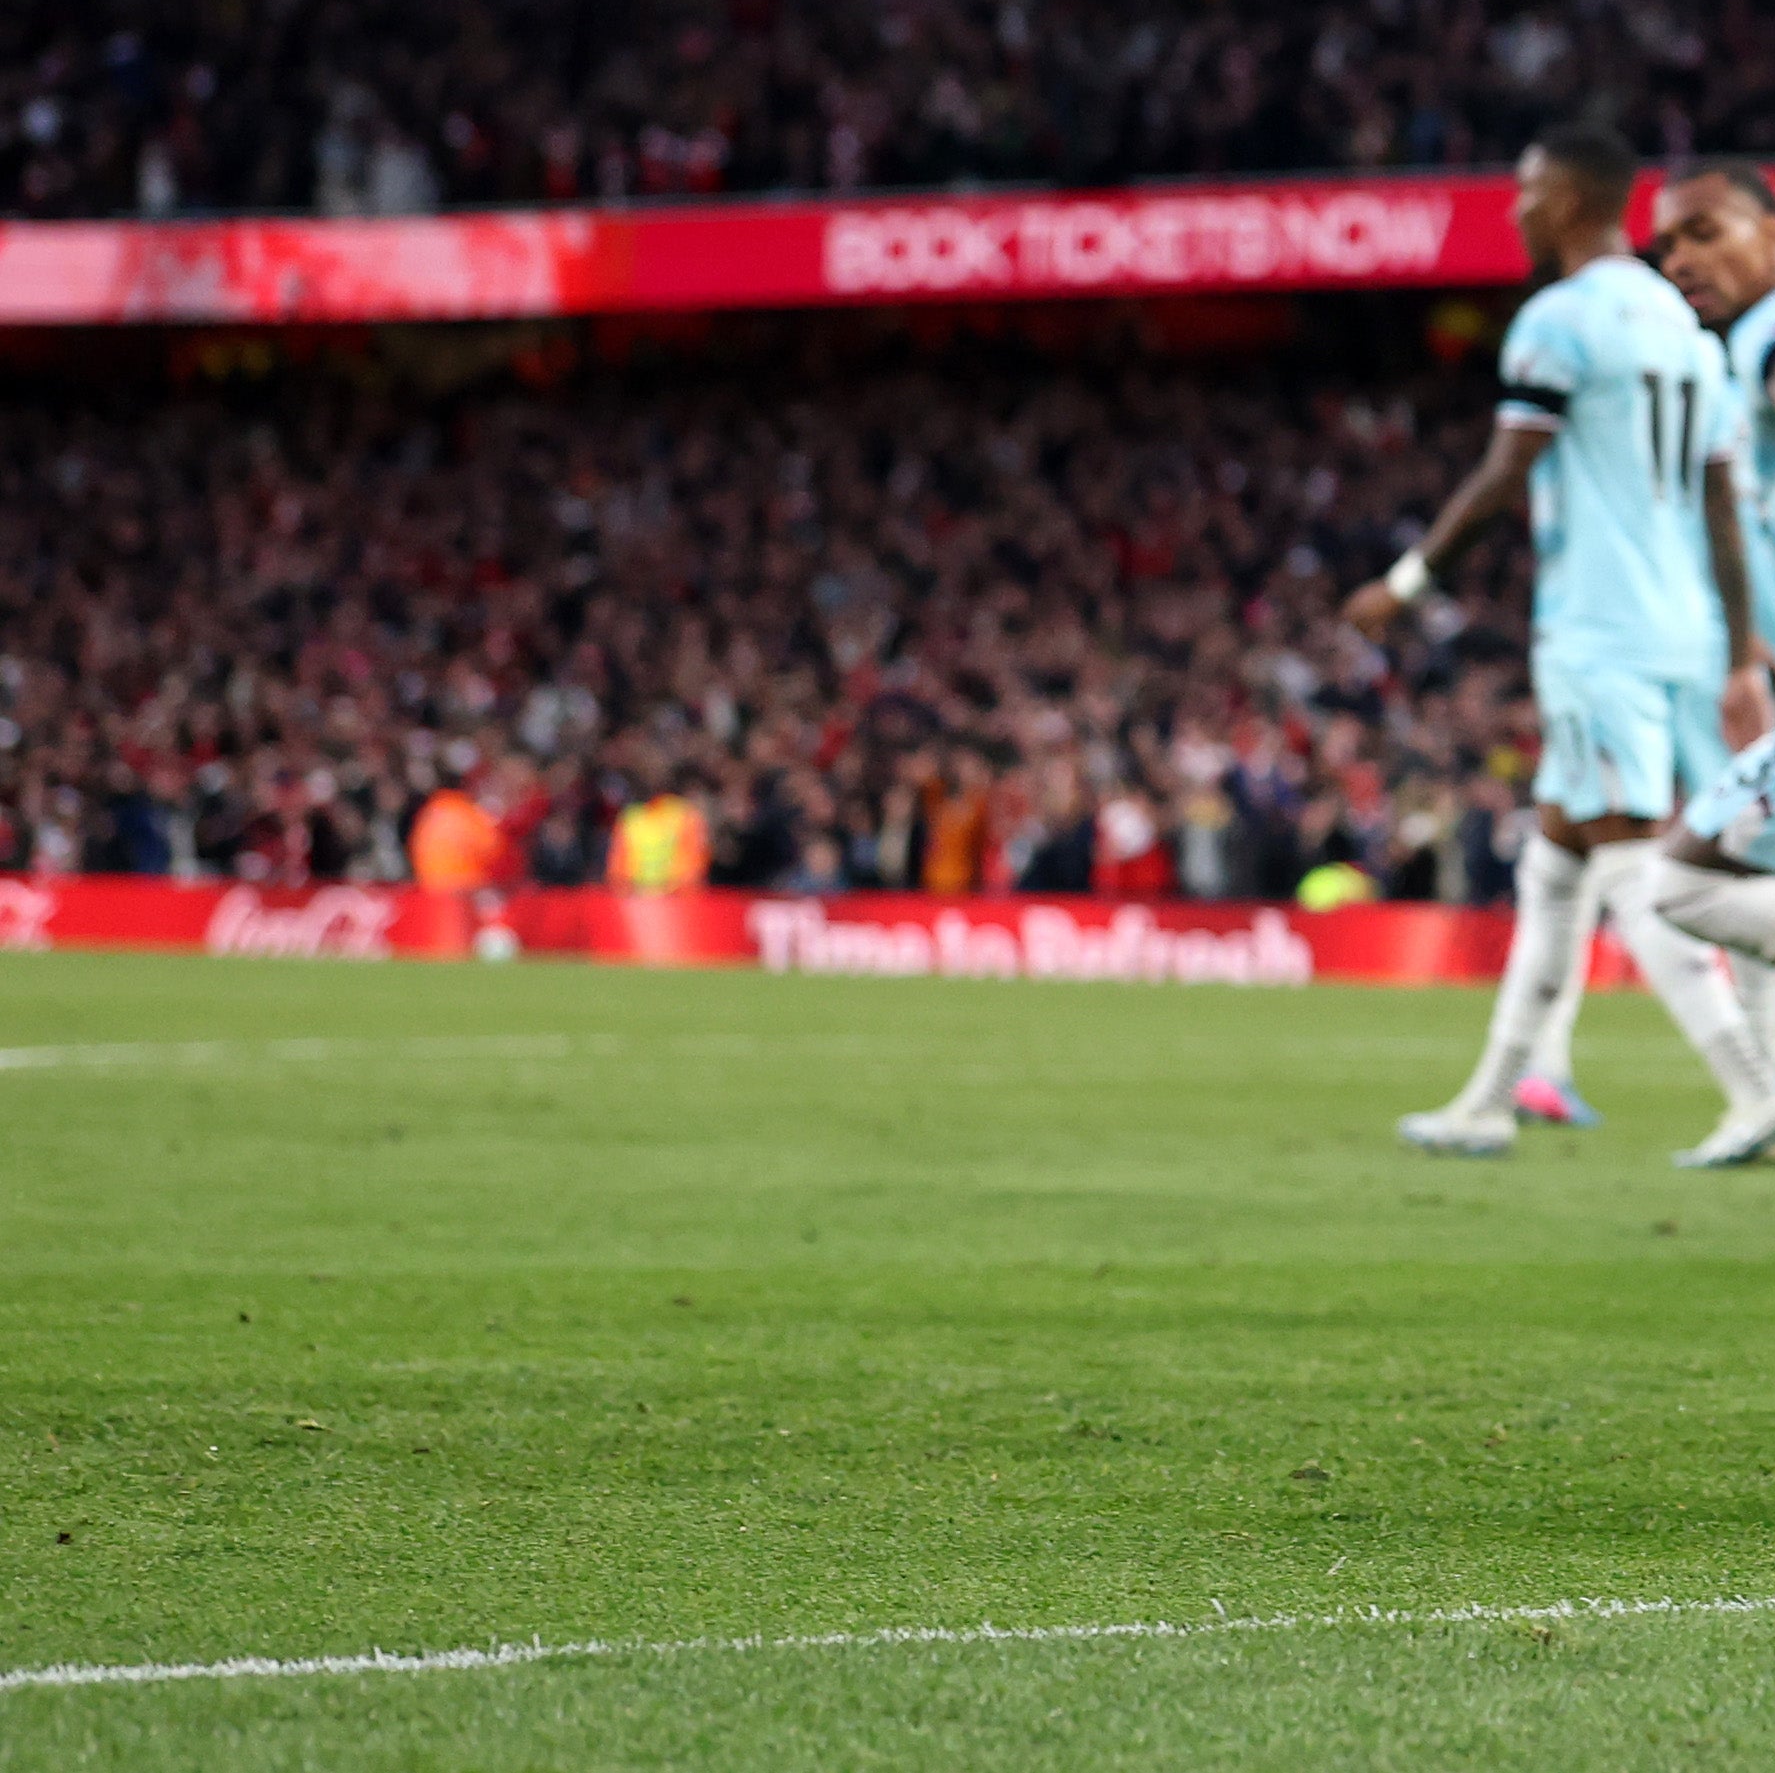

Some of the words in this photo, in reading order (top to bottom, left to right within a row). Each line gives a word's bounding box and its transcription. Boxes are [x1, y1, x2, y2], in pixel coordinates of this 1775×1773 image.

[824, 209, 1014, 294] BOOK
[1284, 190, 1455, 278] NOW
[1643, 370, 1698, 496] 11
[744, 898, 931, 975] Time
[1020, 902, 1314, 988] Refresh
